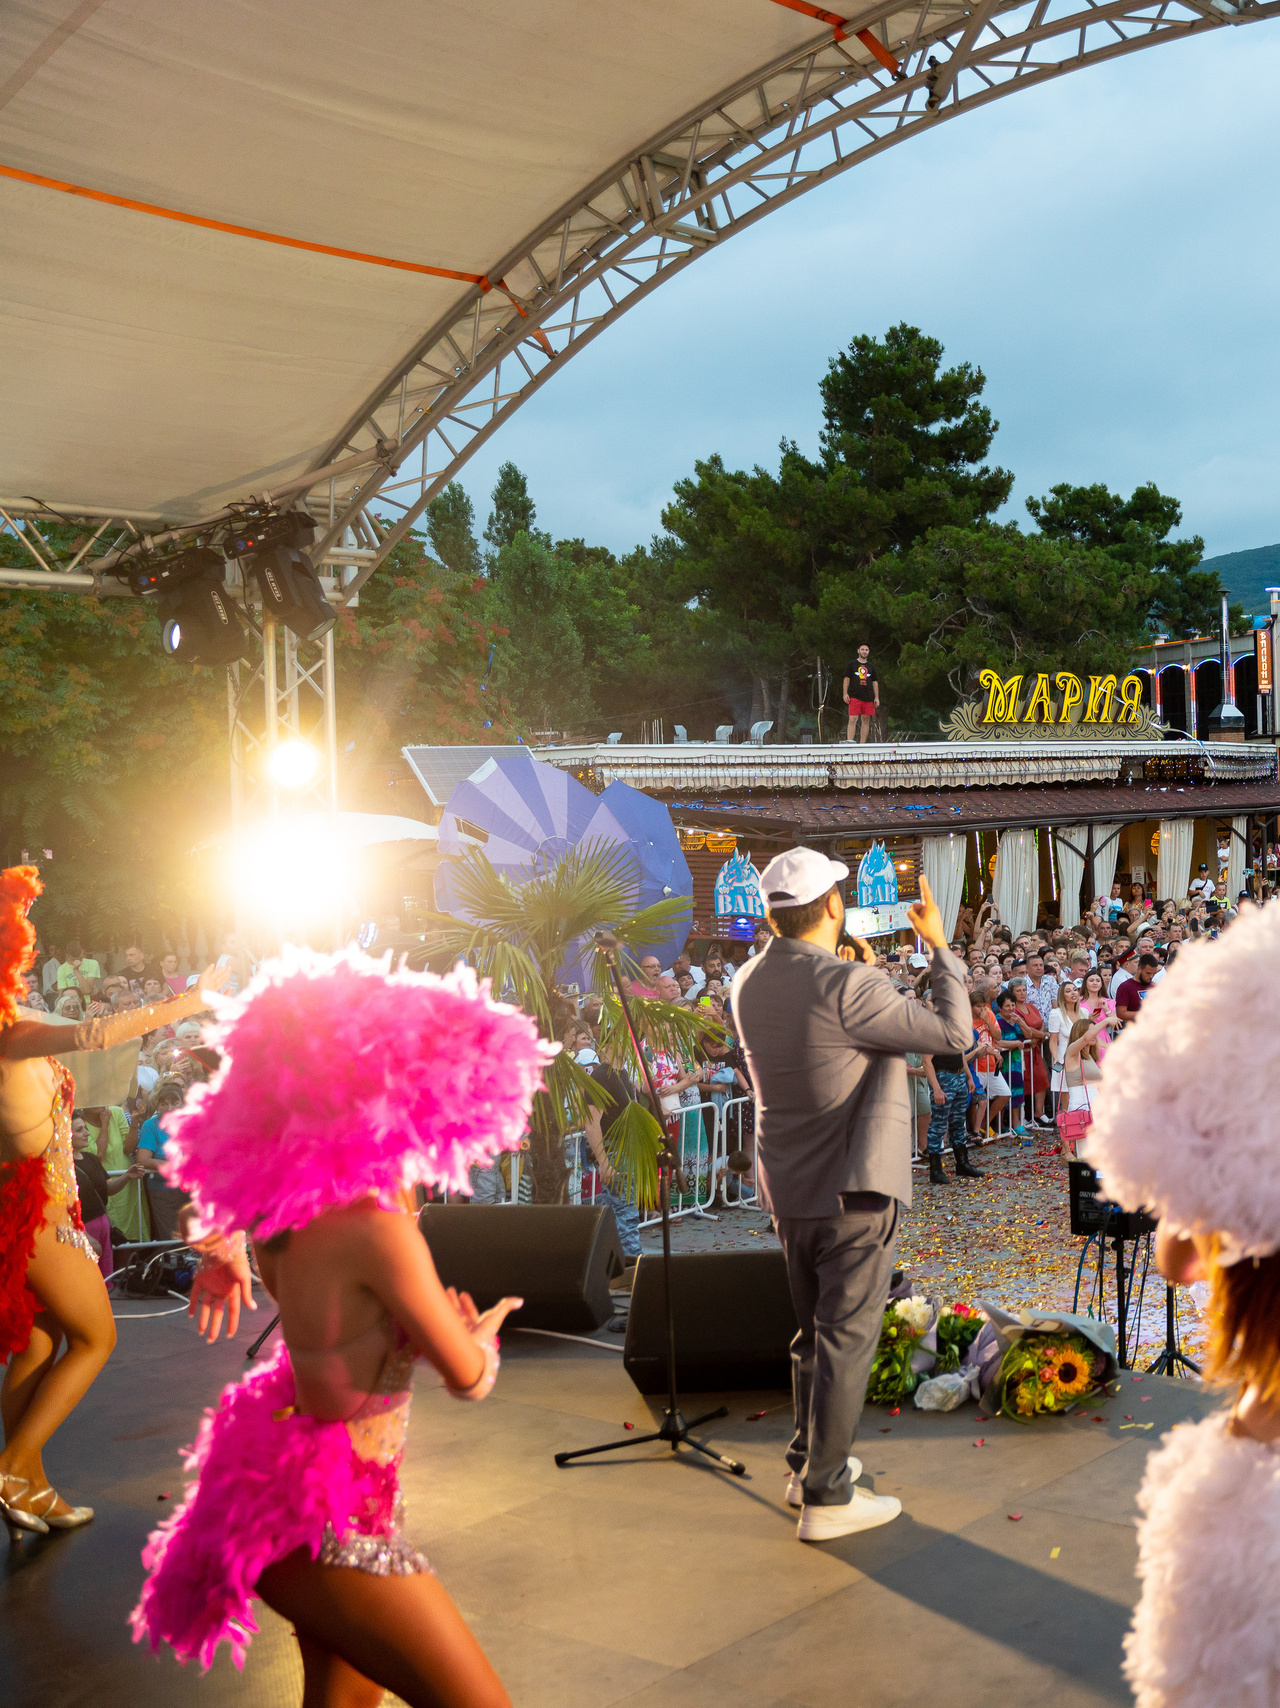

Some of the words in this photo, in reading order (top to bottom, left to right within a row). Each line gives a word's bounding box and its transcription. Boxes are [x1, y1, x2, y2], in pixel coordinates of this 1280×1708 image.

[979, 668, 1144, 724] МАРИЯ
[717, 894, 763, 916] BAR
[861, 885, 897, 906] BAR
